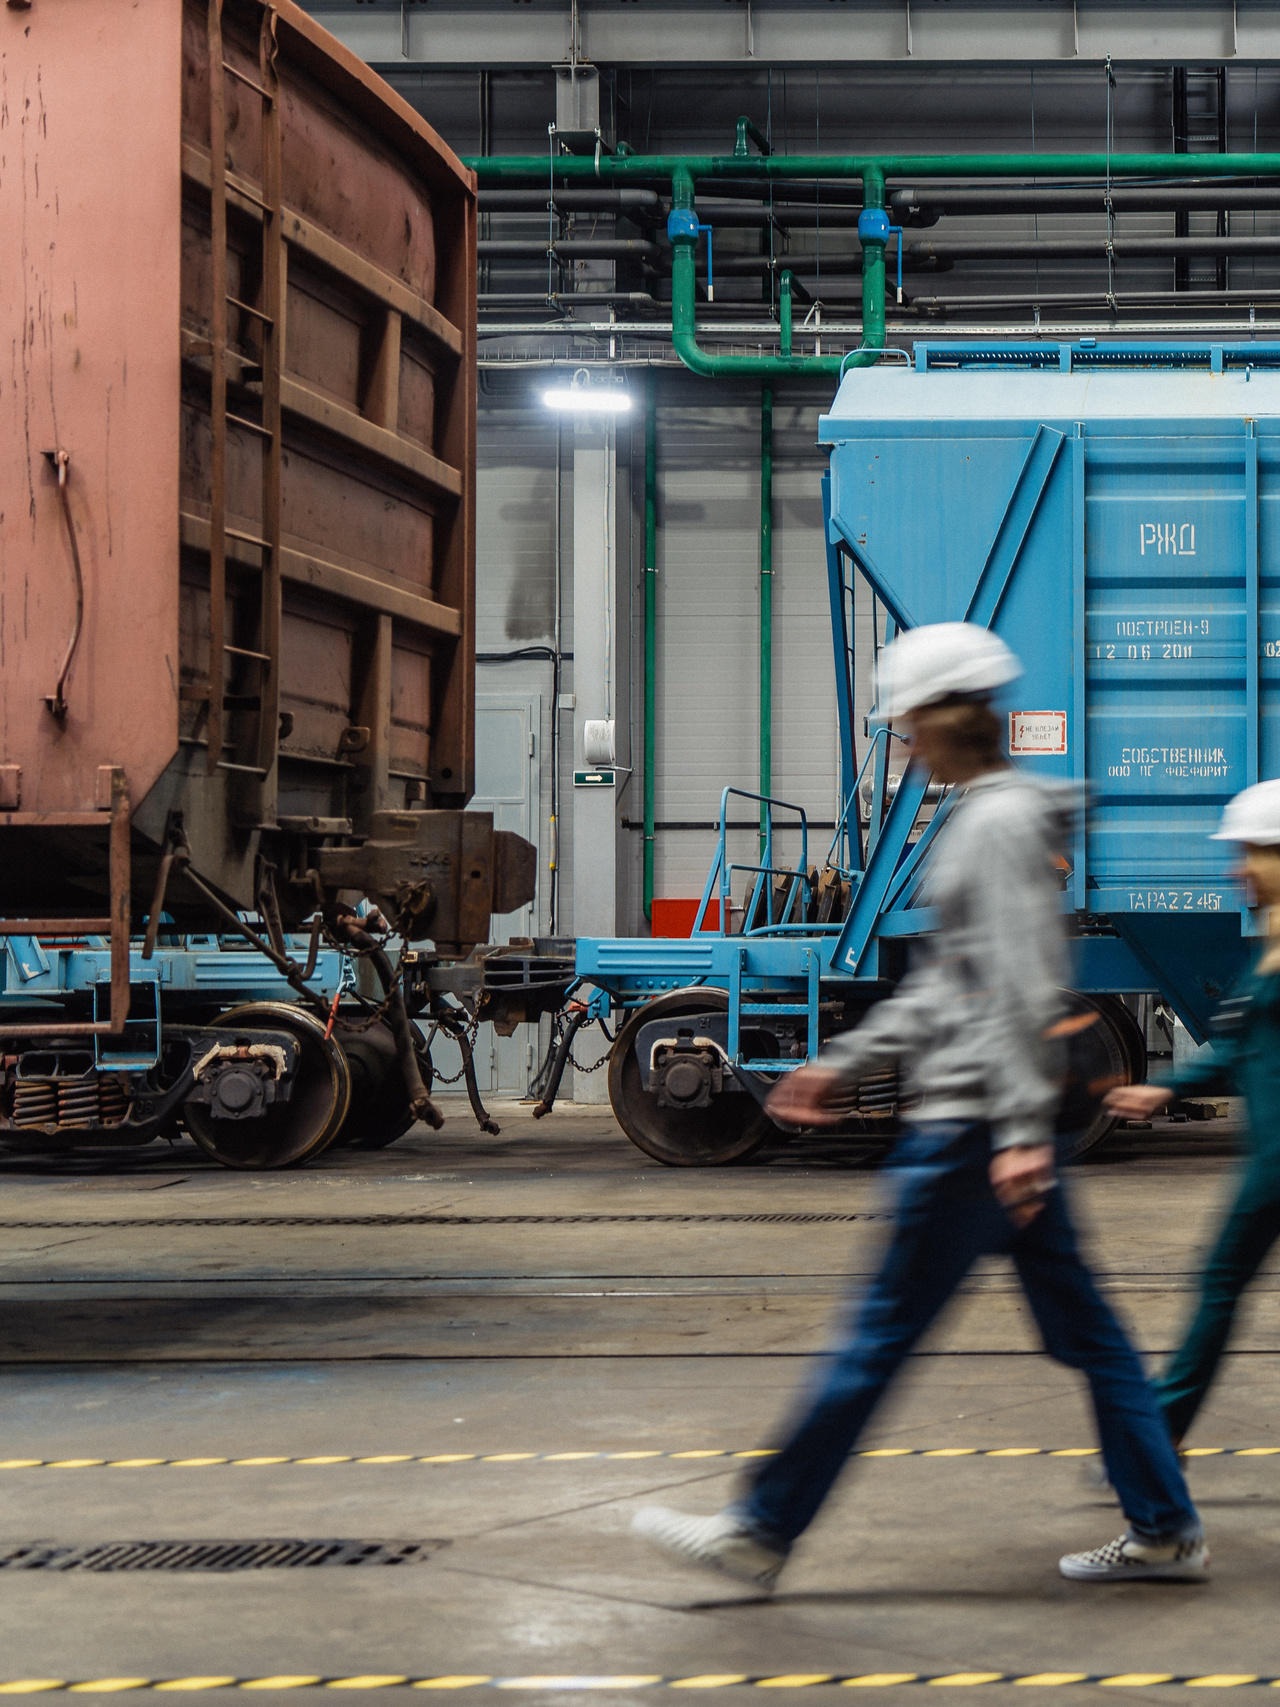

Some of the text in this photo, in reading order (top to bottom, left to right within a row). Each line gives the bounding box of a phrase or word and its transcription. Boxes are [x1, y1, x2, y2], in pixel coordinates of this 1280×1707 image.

[1140, 523, 1196, 555] РЖД
[1117, 620, 1209, 636] ПОСТРОЕН-9
[1162, 643, 1192, 659] 2011
[1122, 748, 1227, 763] СОБСТВЕННИК
[1108, 765, 1130, 776] ООО
